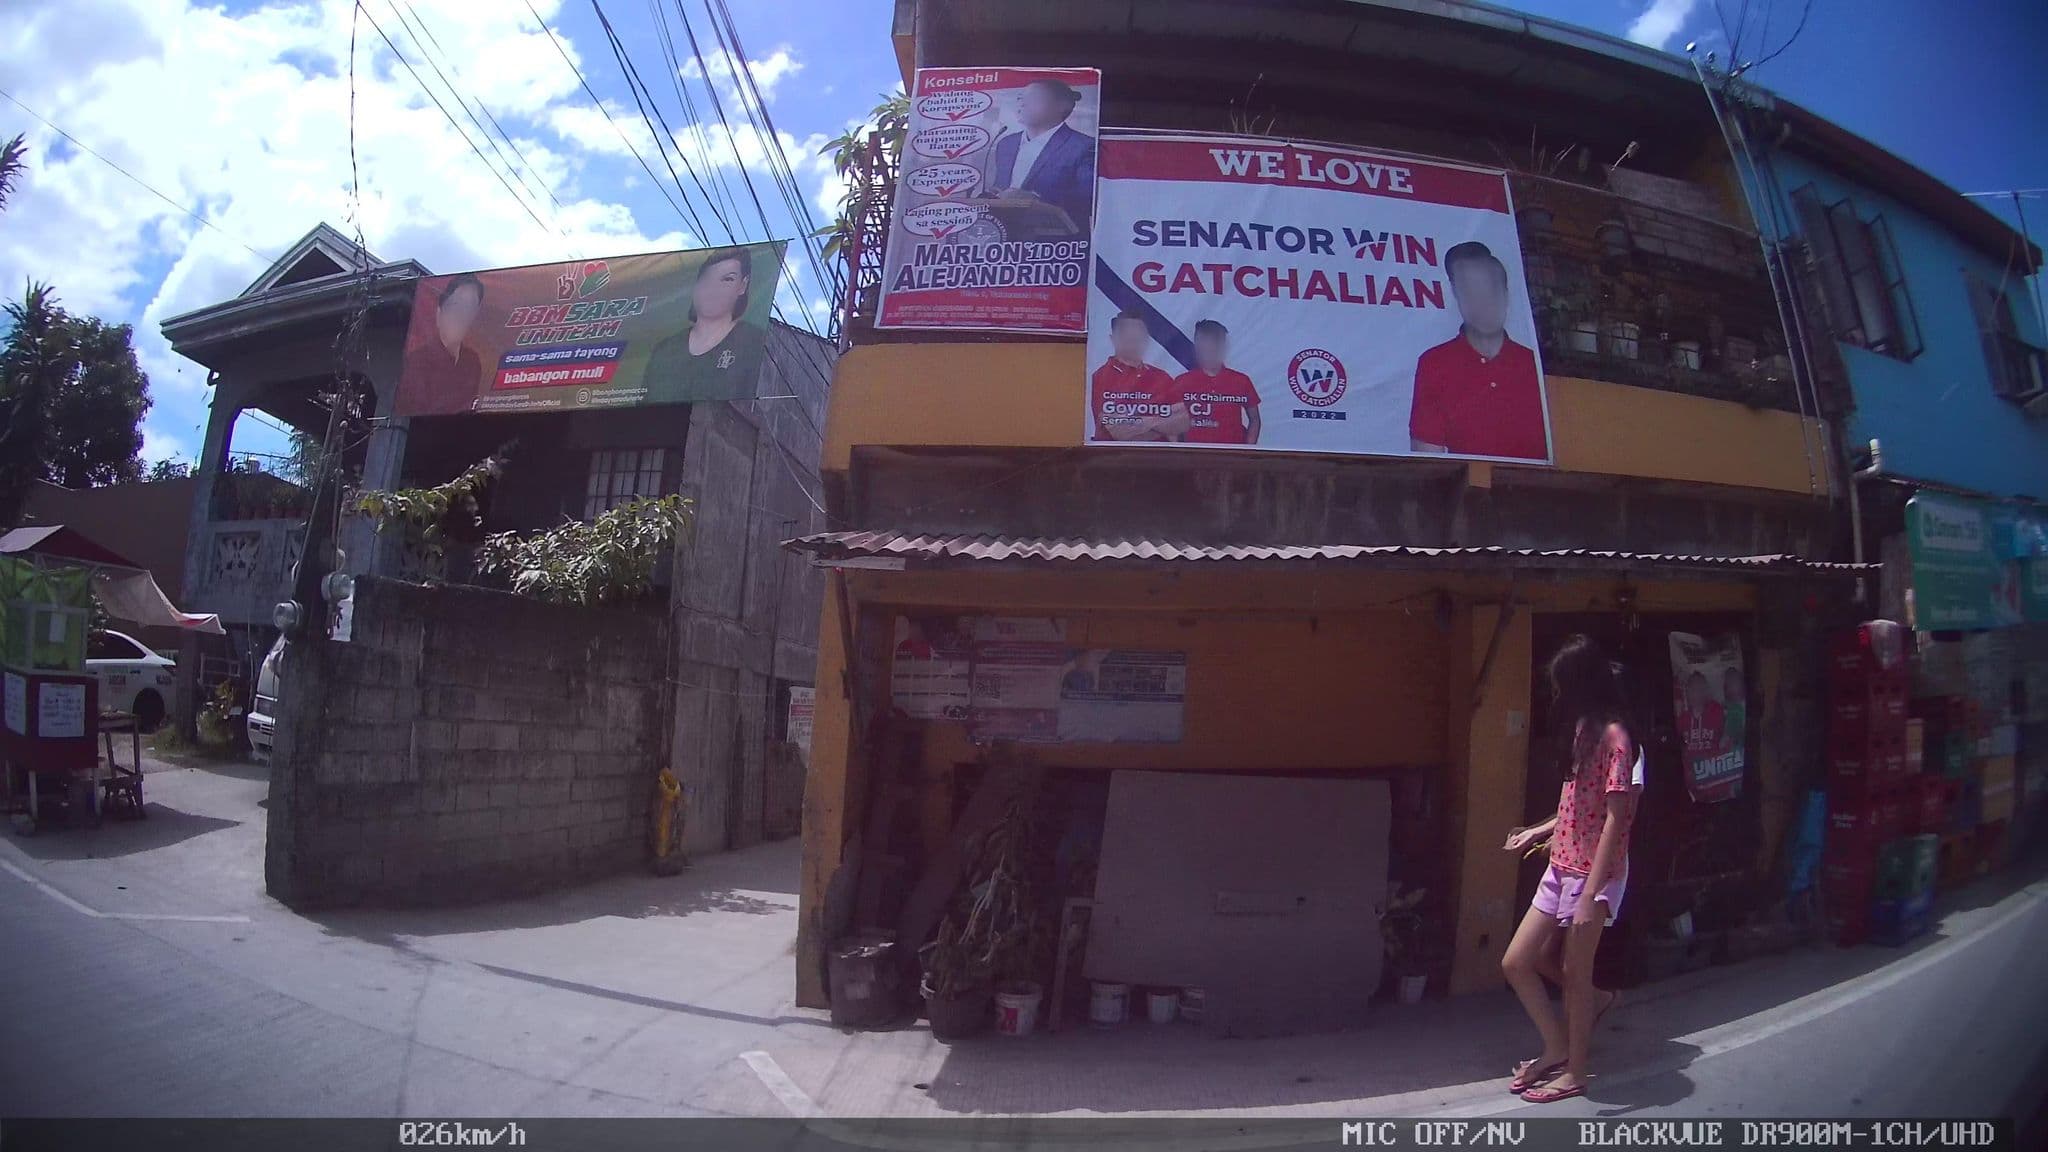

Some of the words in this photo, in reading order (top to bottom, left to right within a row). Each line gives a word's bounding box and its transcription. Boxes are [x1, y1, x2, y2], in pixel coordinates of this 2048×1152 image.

[924, 72, 999, 89] Konsehal
[918, 168, 939, 178] 25
[940, 168, 972, 178] years
[1209, 148, 1285, 180] WE
[1297, 153, 1414, 194] LOVE
[911, 177, 977, 187] Experience
[944, 203, 990, 217] present
[930, 216, 973, 226] session
[1131, 219, 1336, 256] SENATOR
[1342, 227, 1438, 268] WIN
[913, 241, 1023, 268] MARLON
[891, 261, 1082, 293] ALEJANDRINO
[1131, 260, 1446, 310] GATCHALIAN
[516, 319, 624, 346] UNITEAM
[505, 350, 572, 364] sama-sama
[574, 347, 618, 360] tayong
[1296, 350, 1336, 363] SENATOR
[503, 370, 569, 385] babangon
[571, 366, 605, 380] muli
[1102, 391, 1153, 400] Councilor
[1183, 392, 1199, 401] SK
[1200, 393, 1248, 404] Chairman
[1300, 378, 1346, 407] GATCHALIAN
[1102, 400, 1172, 417] Goyong
[1189, 402, 1212, 416] CJ
[1301, 411, 1337, 420] 2022
